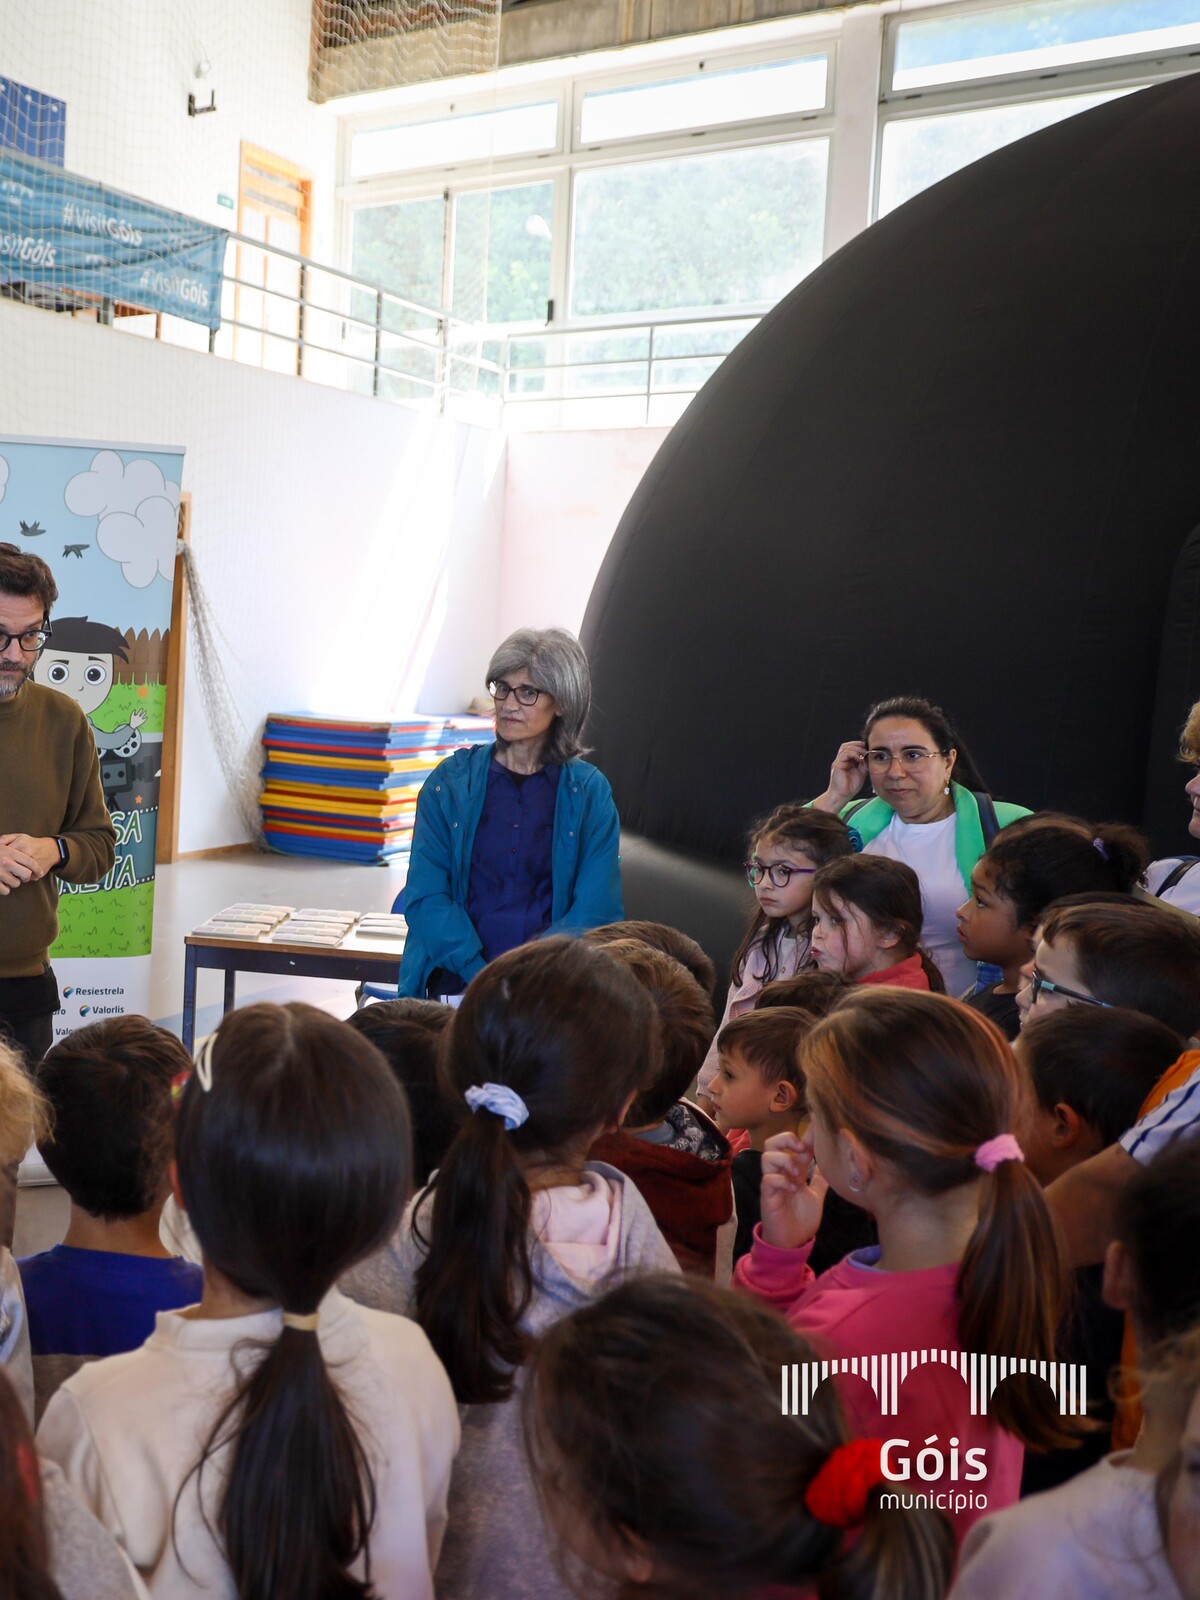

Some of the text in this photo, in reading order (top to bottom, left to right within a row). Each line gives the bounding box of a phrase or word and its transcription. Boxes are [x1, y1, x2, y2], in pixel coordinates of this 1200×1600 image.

[63, 202, 143, 247] #VisitGóis
[75, 987, 124, 996] Resiestrela
[92, 1006, 125, 1014] Valorlis
